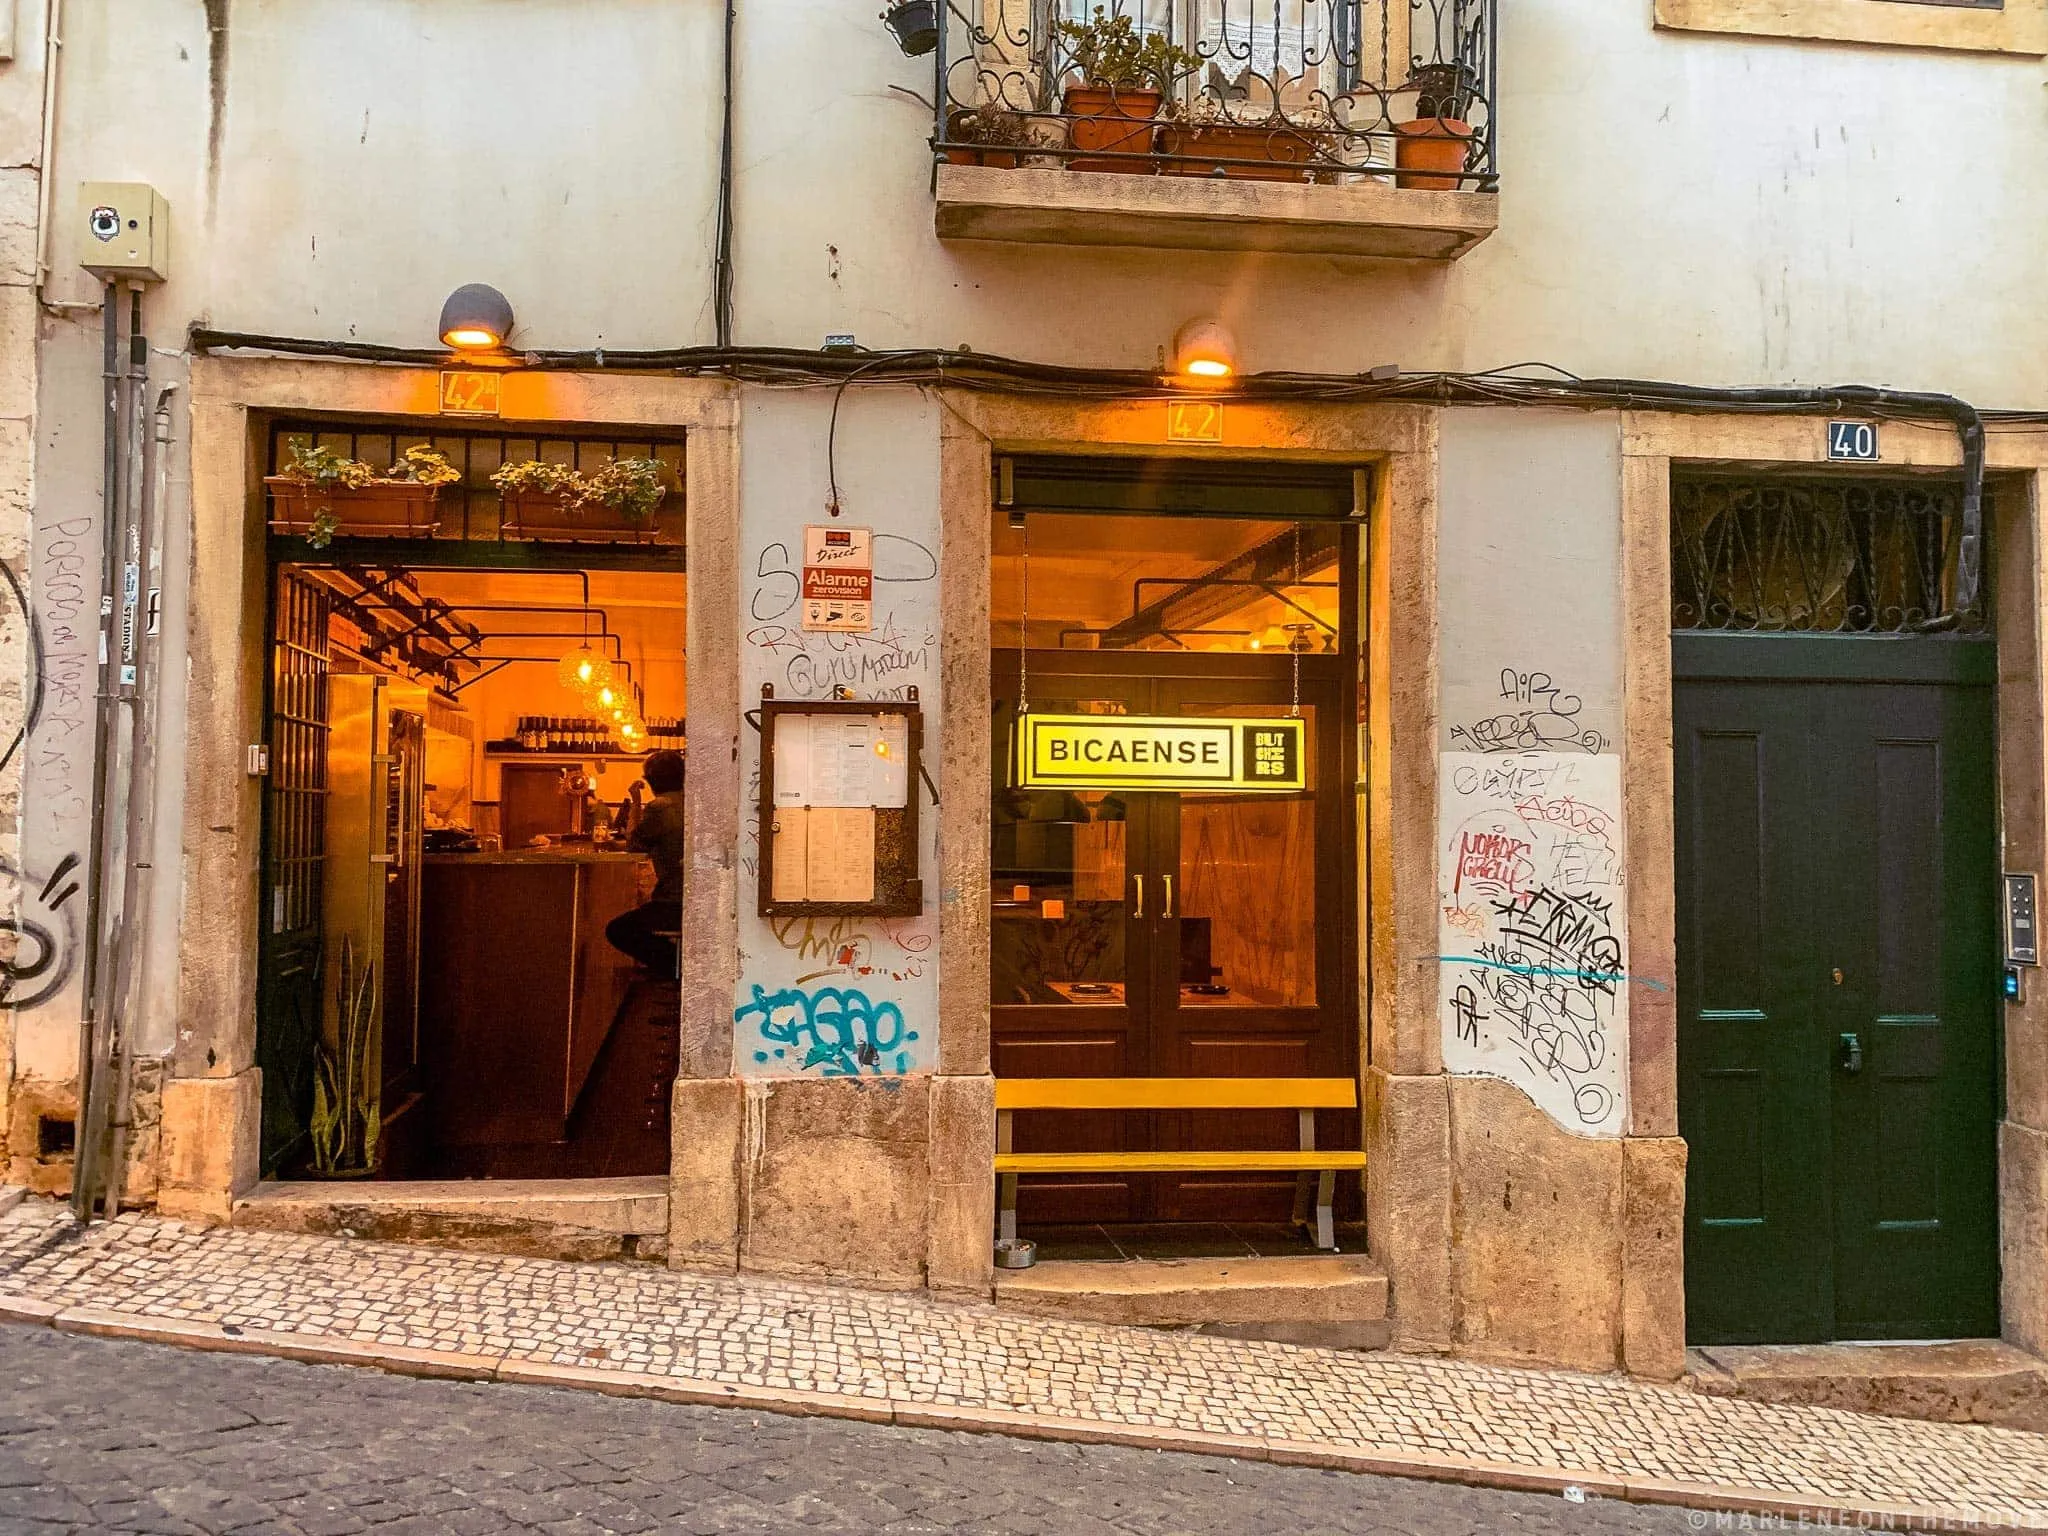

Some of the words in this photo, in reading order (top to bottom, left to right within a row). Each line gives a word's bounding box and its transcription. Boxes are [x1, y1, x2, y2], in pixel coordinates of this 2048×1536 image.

[1174, 403, 1215, 438] 42
[1834, 423, 1873, 457] 40
[806, 569, 869, 588] Alarme
[812, 586, 863, 596] zerovision
[1050, 738, 1220, 765] BICAENSE
